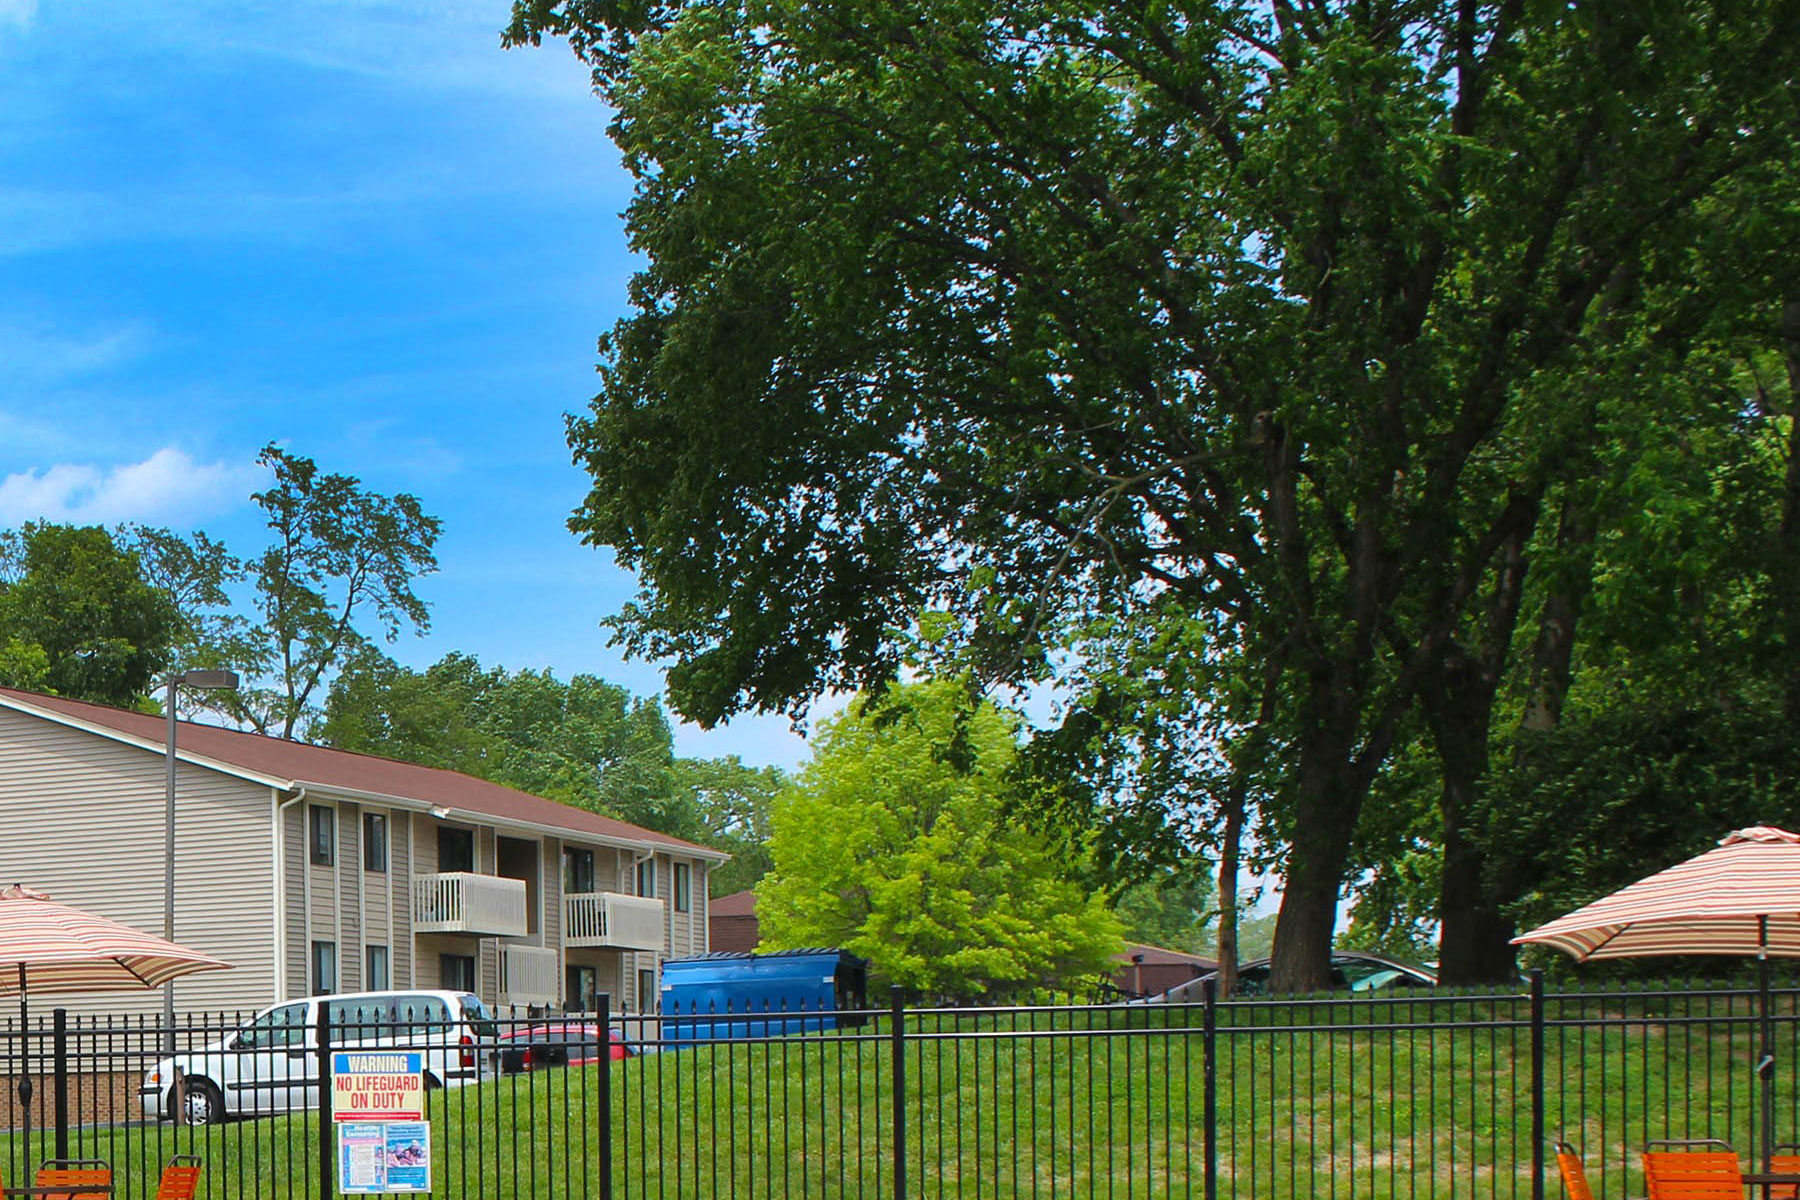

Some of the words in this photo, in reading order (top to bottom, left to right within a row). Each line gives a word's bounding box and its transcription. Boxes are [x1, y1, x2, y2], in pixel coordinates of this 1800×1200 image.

[348, 1055, 408, 1073] WARNING
[336, 1076, 352, 1091] NO
[356, 1076, 419, 1091] LIFEGUARD
[351, 1093, 368, 1108] ON
[373, 1093, 405, 1108] DUTY
